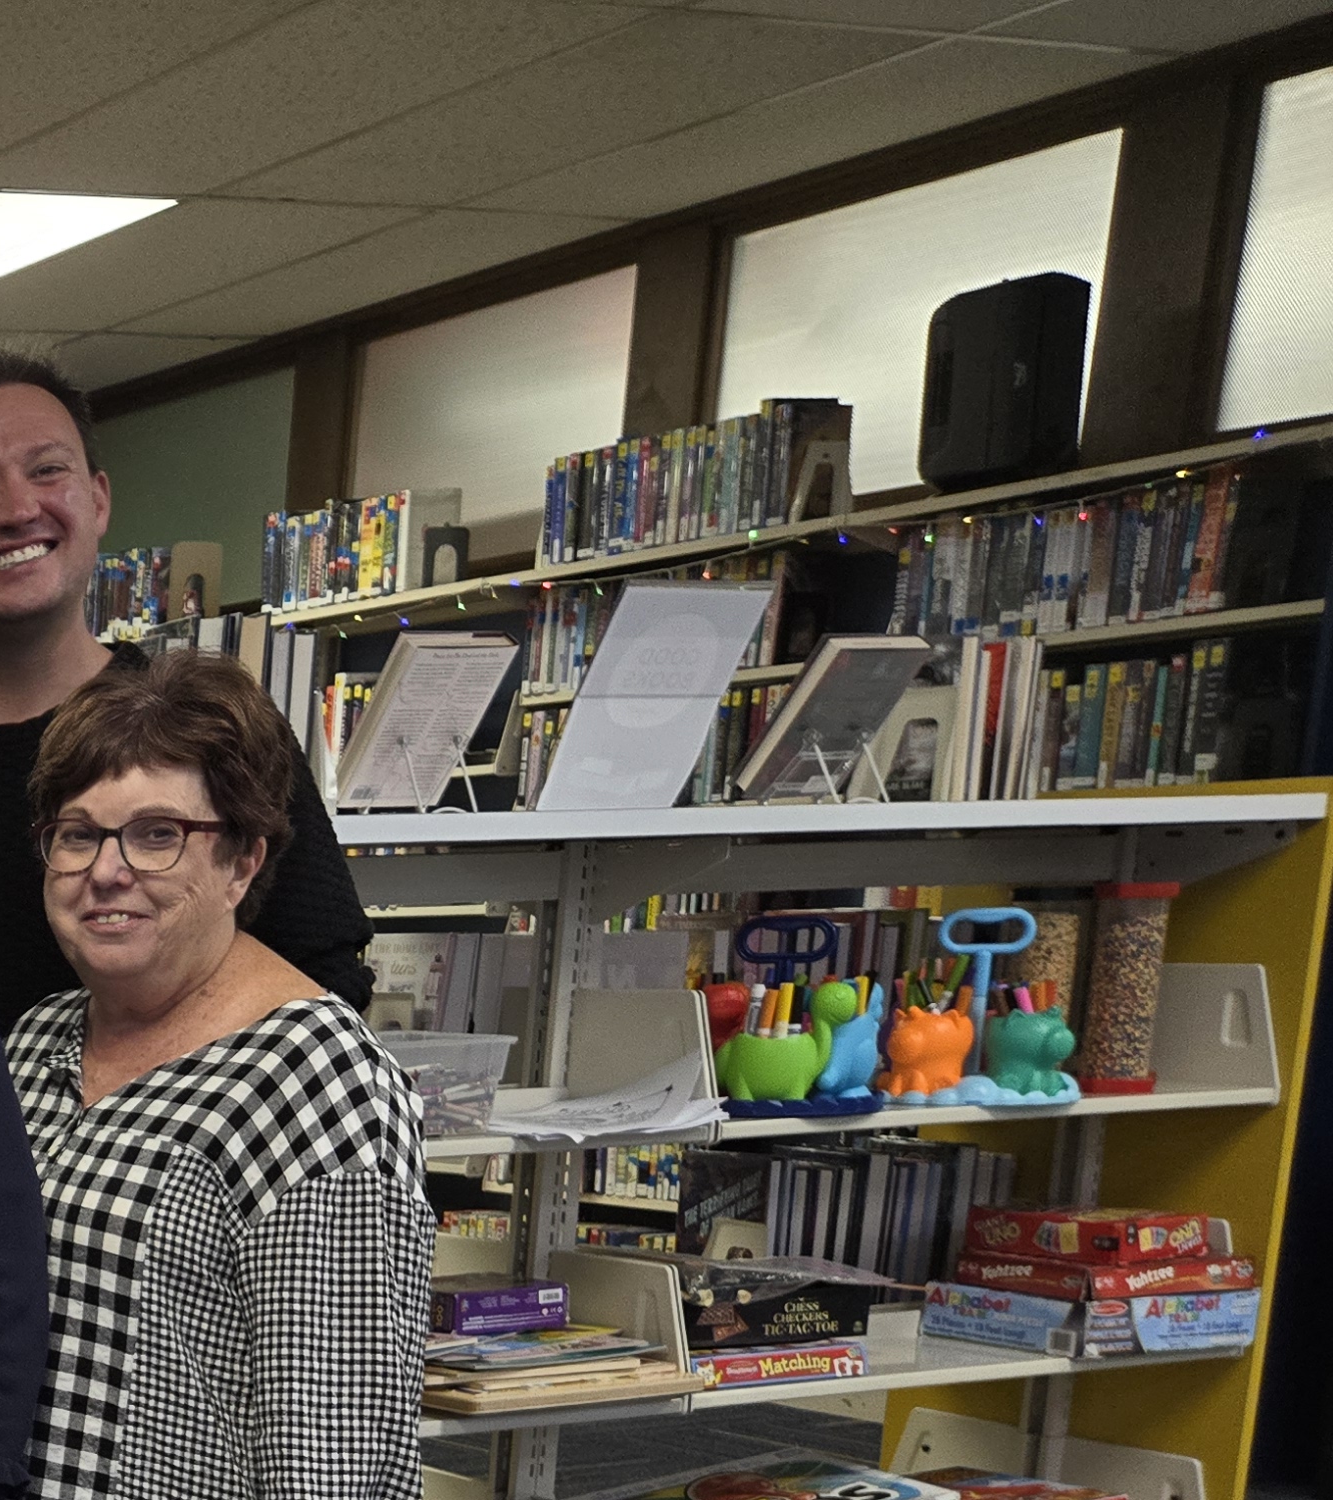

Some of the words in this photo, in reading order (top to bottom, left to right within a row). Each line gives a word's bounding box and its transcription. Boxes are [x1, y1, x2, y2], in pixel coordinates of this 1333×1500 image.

[985, 1221, 1021, 1245] UNO
[1170, 1217, 1200, 1247] UNO
[982, 1264, 1033, 1280] Yahtzee
[1126, 1266, 1175, 1291] Yahtzee
[773, 1311, 829, 1323] CHECKERS
[784, 1301, 819, 1313] CHESS
[758, 1353, 830, 1378] Matching
